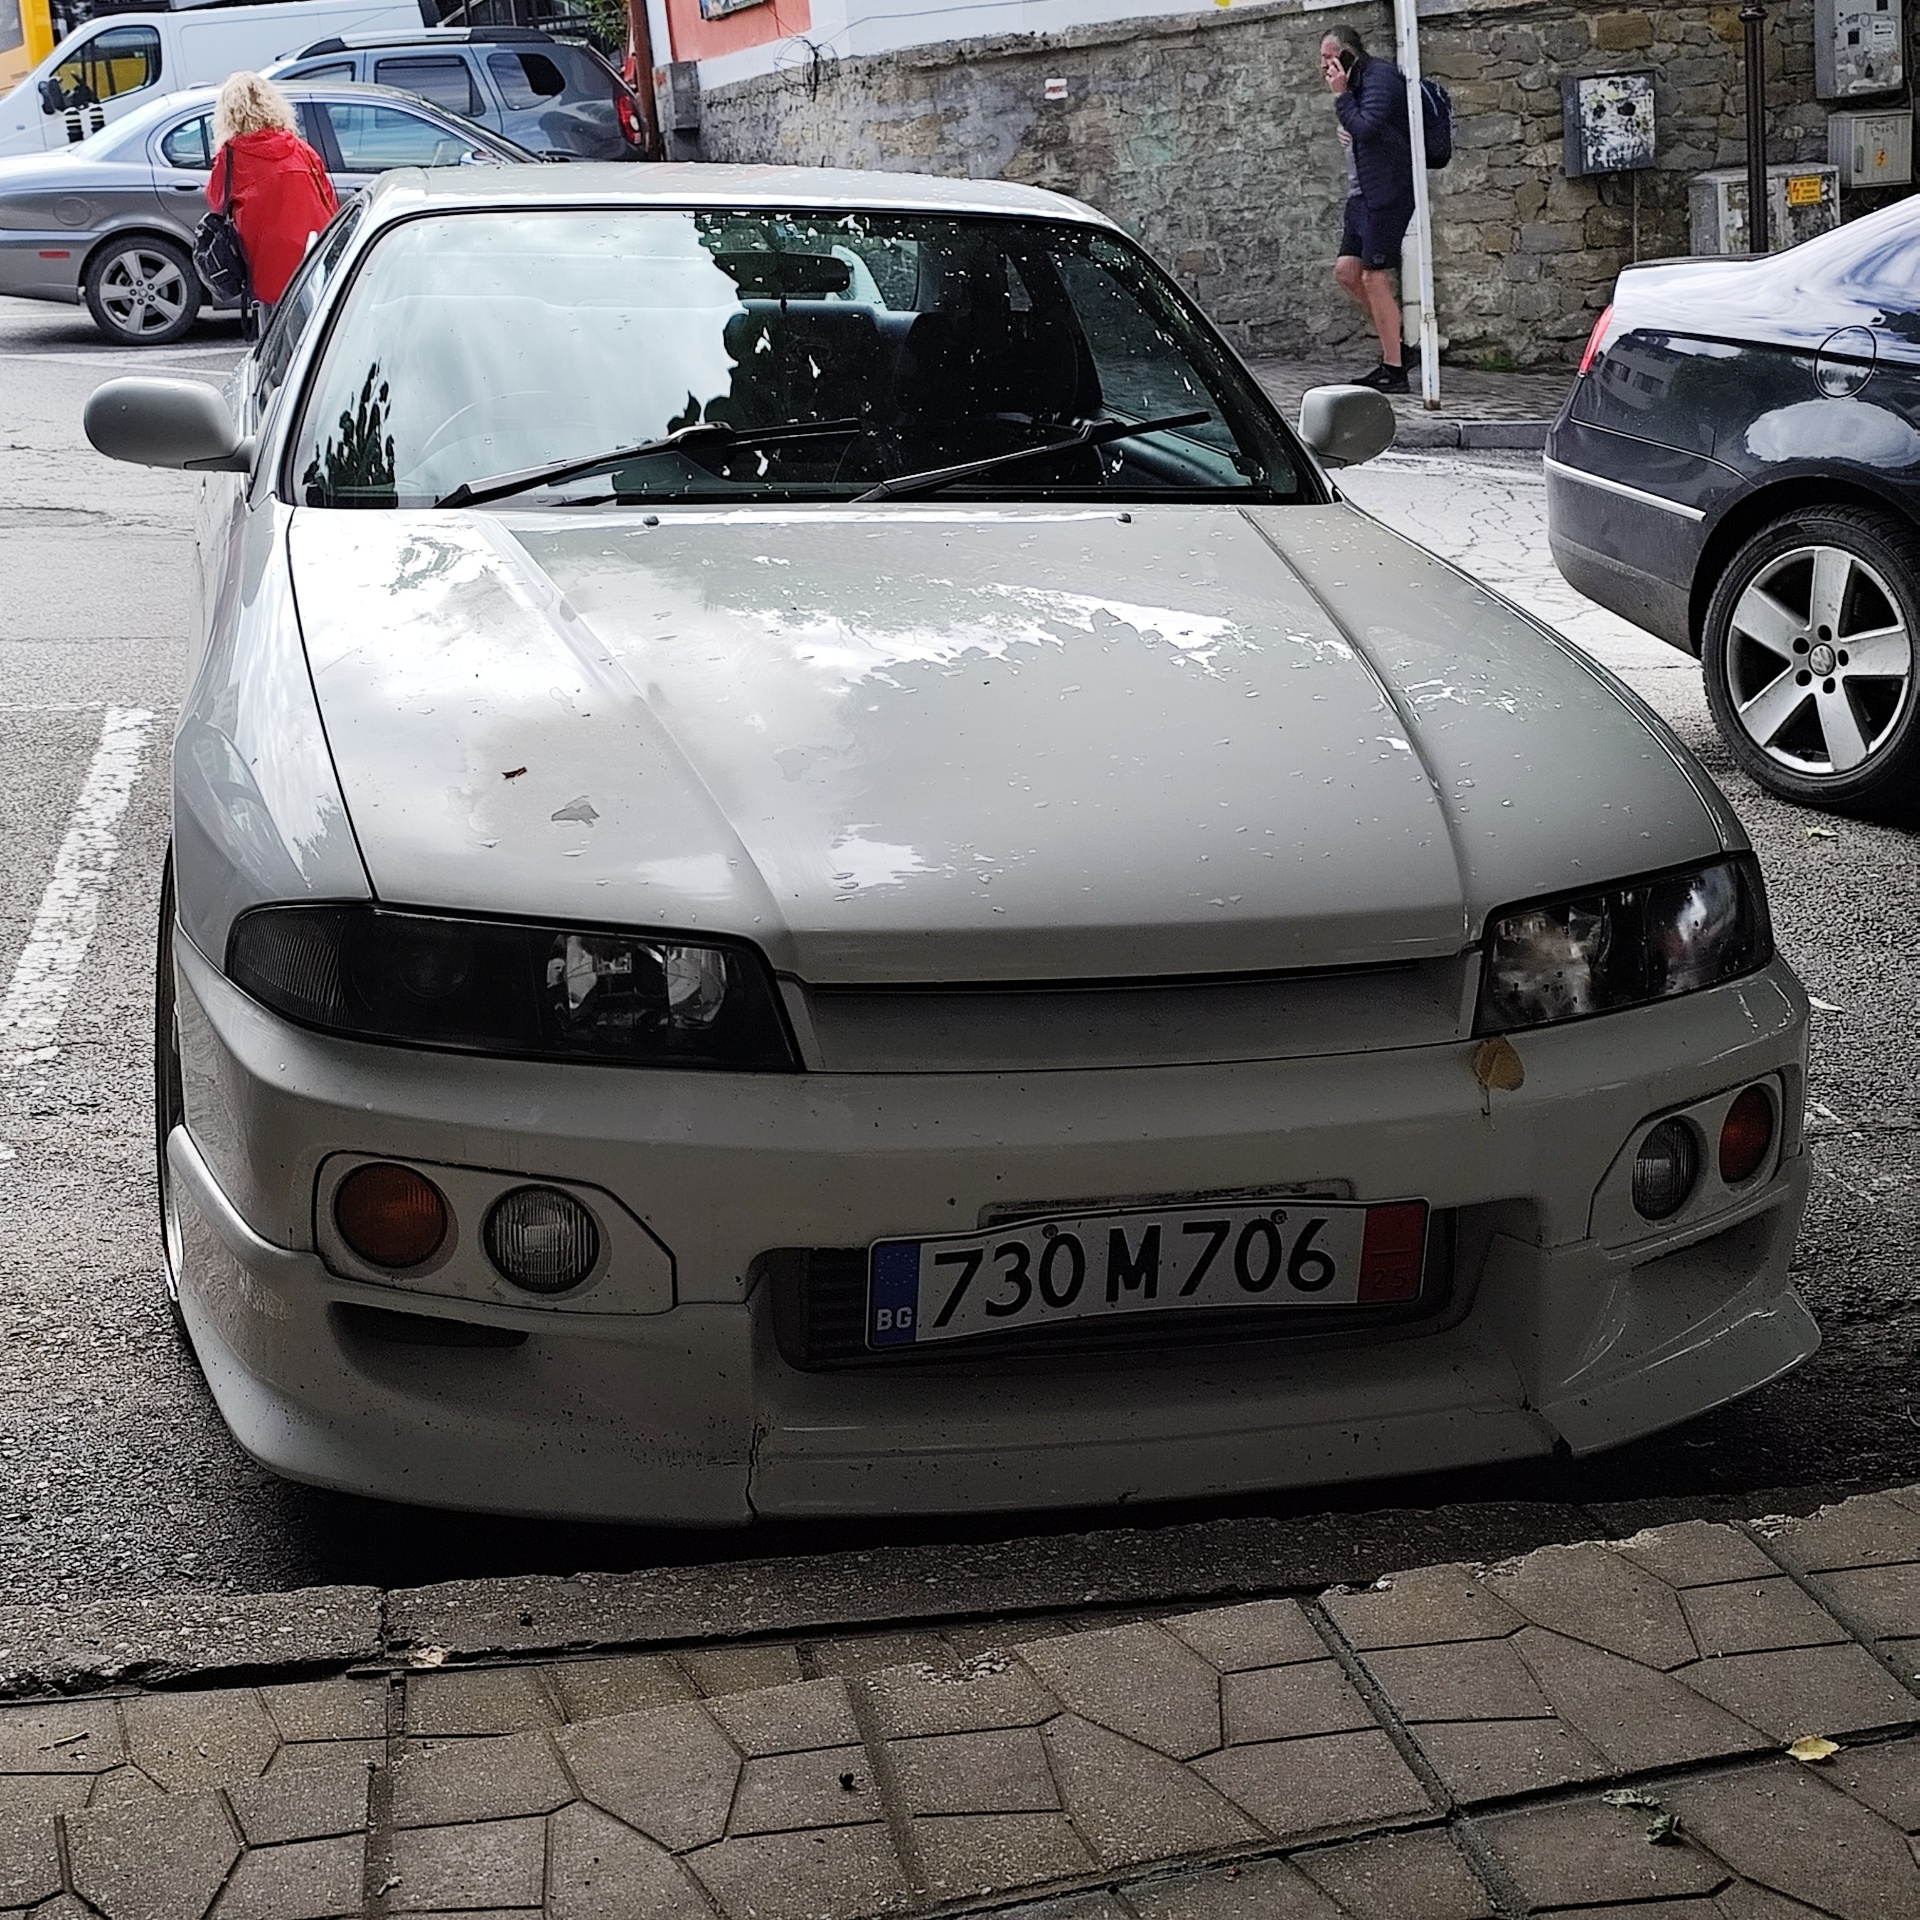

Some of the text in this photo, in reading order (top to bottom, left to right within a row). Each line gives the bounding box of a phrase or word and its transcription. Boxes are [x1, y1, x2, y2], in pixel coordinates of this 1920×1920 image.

[933, 1218, 1337, 1329] 730 M 706
[877, 1307, 913, 1331] BG
